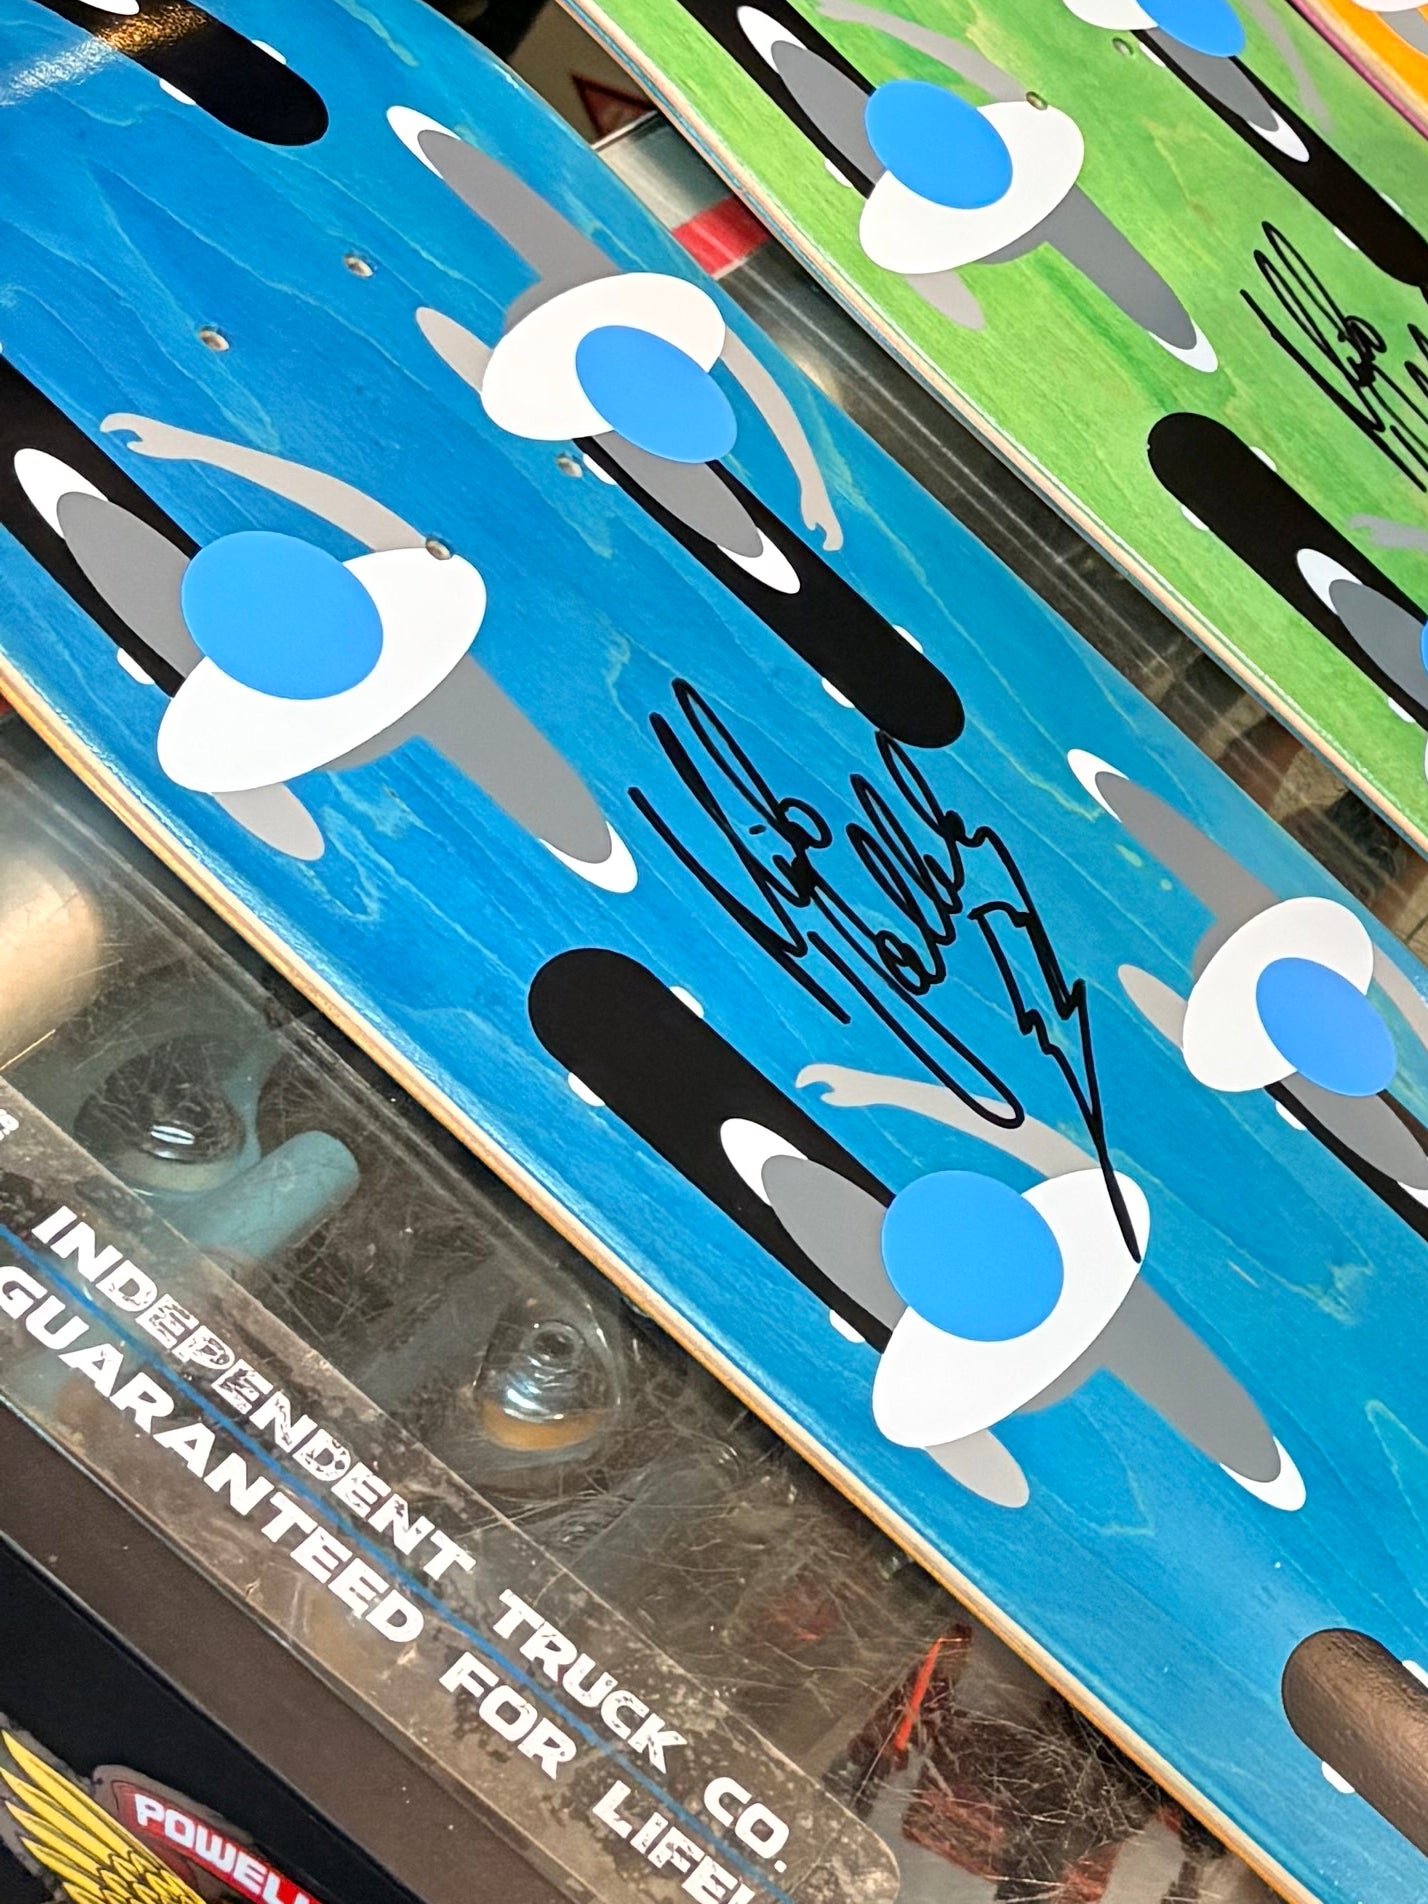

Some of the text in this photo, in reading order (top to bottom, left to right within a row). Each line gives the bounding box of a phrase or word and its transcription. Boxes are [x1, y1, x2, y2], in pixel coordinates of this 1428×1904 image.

[0, 1265, 425, 1644] GUARANTEED
[438, 1651, 578, 1780] FOR
[31, 1205, 791, 1873] INDEPENDENT TRUCK CO.
